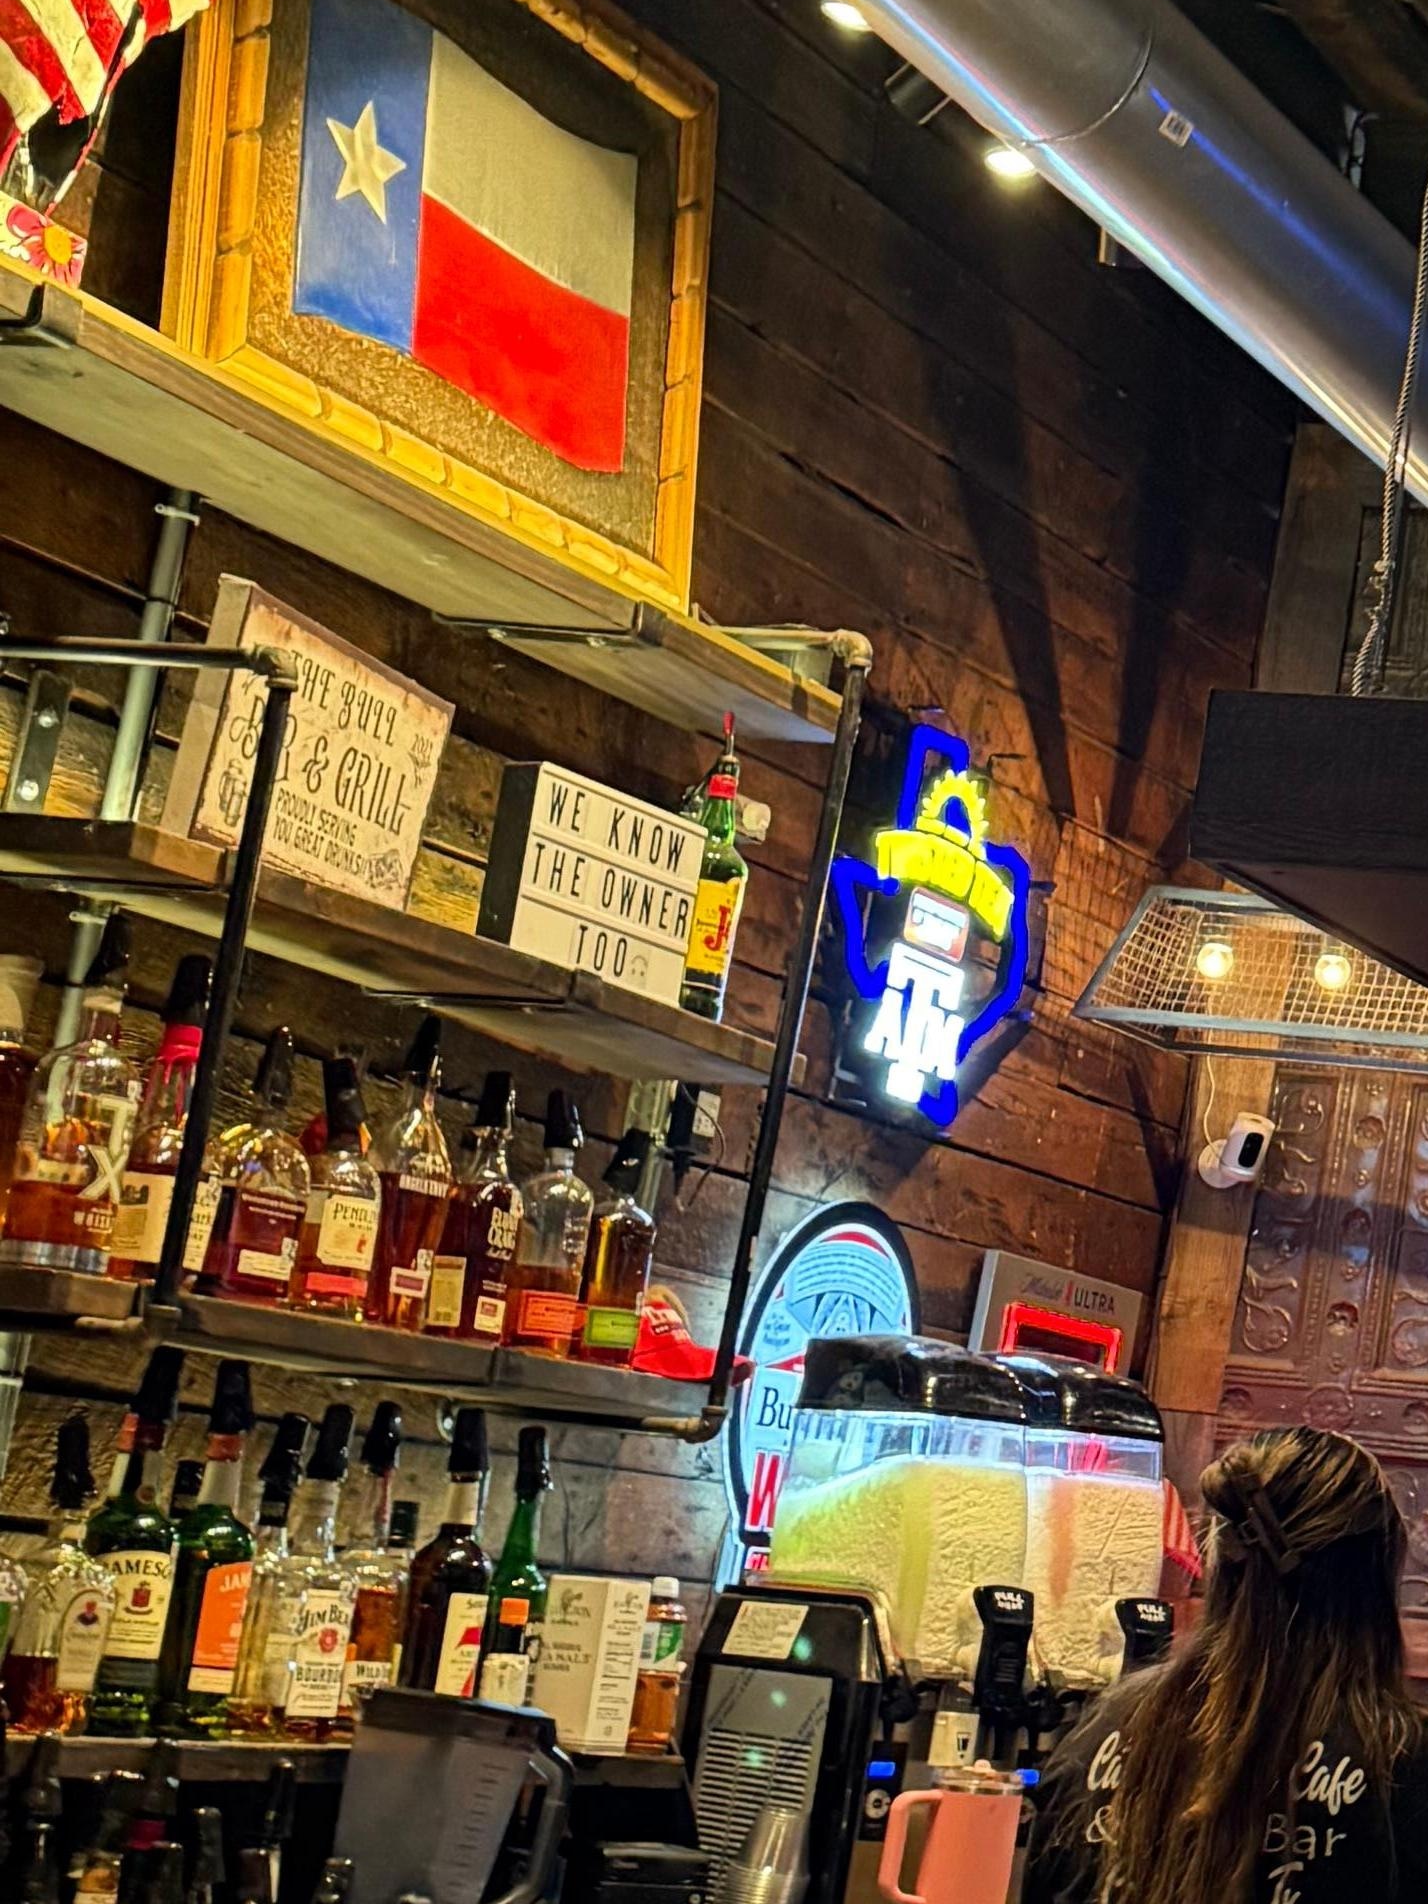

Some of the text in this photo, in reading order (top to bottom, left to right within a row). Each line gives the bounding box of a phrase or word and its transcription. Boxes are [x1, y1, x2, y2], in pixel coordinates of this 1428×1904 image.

[290, 649, 399, 748] THE BULL
[301, 734, 331, 795] &
[334, 746, 413, 837] GRILL
[318, 807, 359, 848] SERVING
[549, 781, 687, 873] WE KNOW
[532, 842, 690, 940] THE OWNER
[576, 924, 628, 978] TOO
[1073, 1288, 1117, 1316] ULTRA
[1263, 1812, 1349, 1861] Bar
